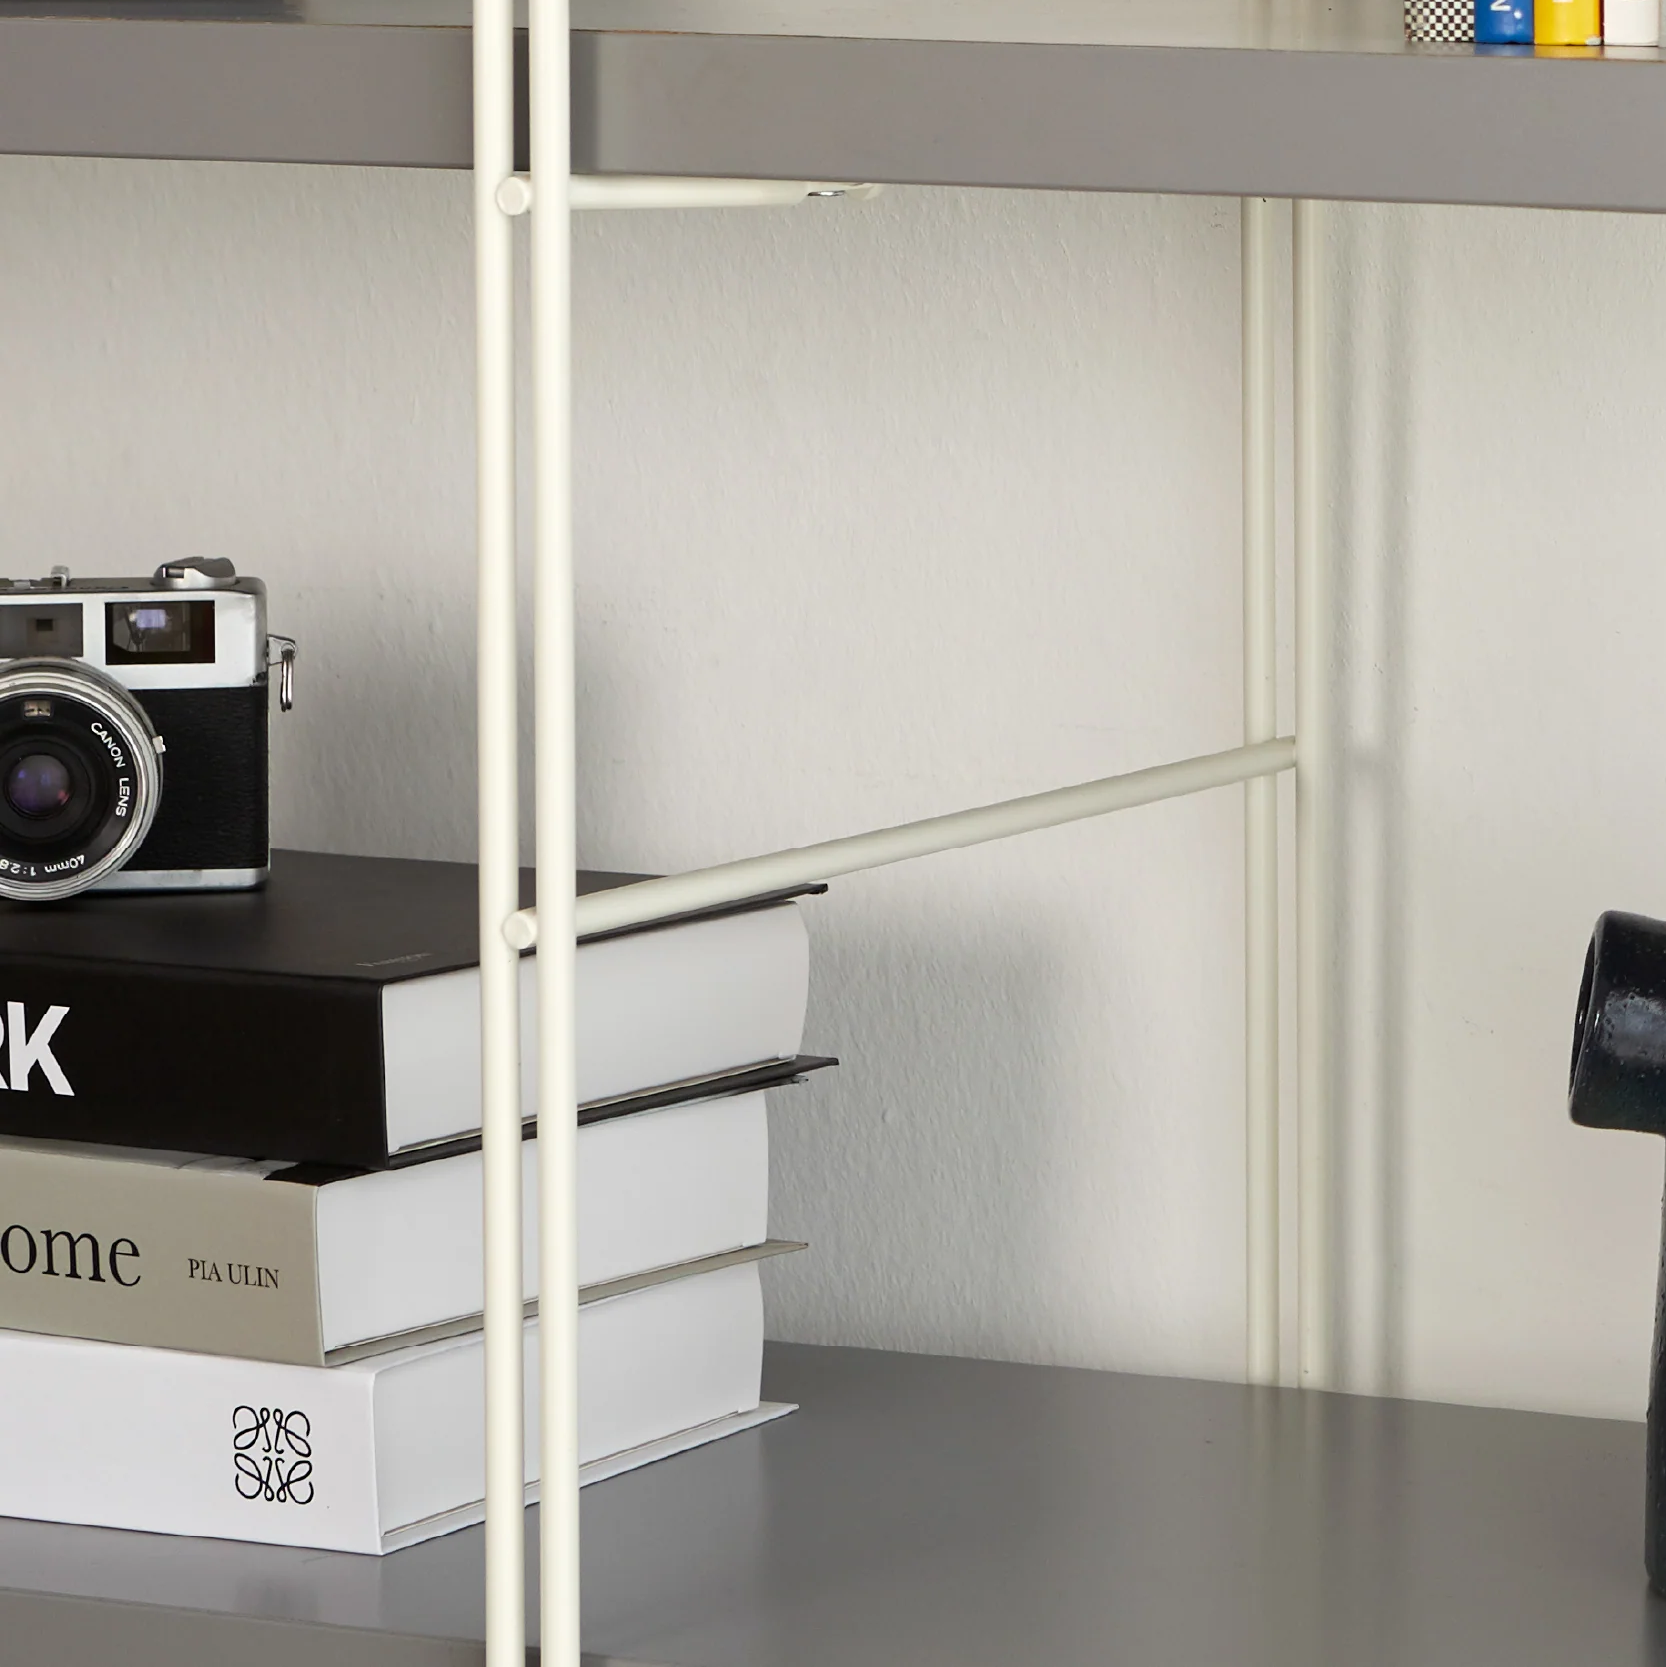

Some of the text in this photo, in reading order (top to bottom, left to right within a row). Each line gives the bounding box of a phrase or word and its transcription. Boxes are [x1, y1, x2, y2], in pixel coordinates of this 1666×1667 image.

[91, 722, 130, 817] CANON LENS
[44, 854, 86, 873] 40mm
[0, 1000, 75, 1097] K
[0, 1224, 141, 1287] ome
[187, 1257, 279, 1289] PIA ULIN
